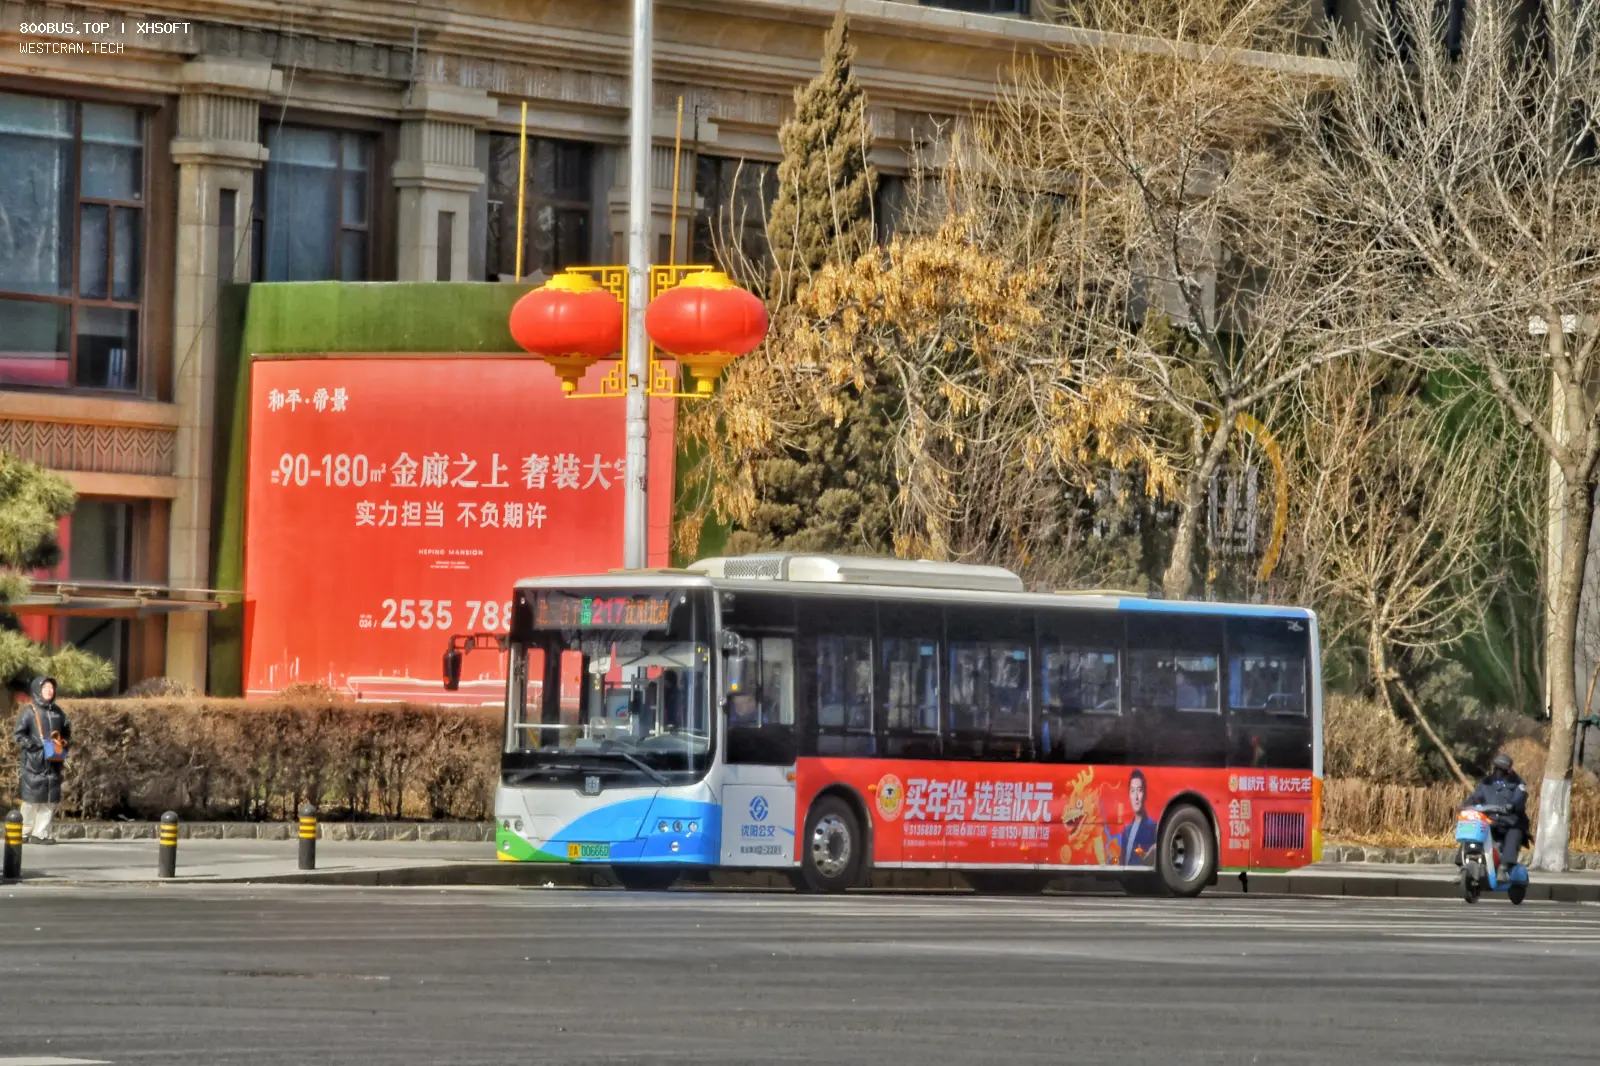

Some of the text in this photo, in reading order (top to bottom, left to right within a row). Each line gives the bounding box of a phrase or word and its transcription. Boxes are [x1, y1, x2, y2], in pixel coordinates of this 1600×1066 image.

[390, 451, 510, 489] 金廊之上
[355, 500, 547, 529] 实力担当 不负期许
[448, 548, 484, 556] MANSION
[381, 599, 452, 630] 2535
[592, 597, 628, 624] 217
[1228, 798, 1252, 820] 全国
[741, 824, 776, 838] 沈阳公交
